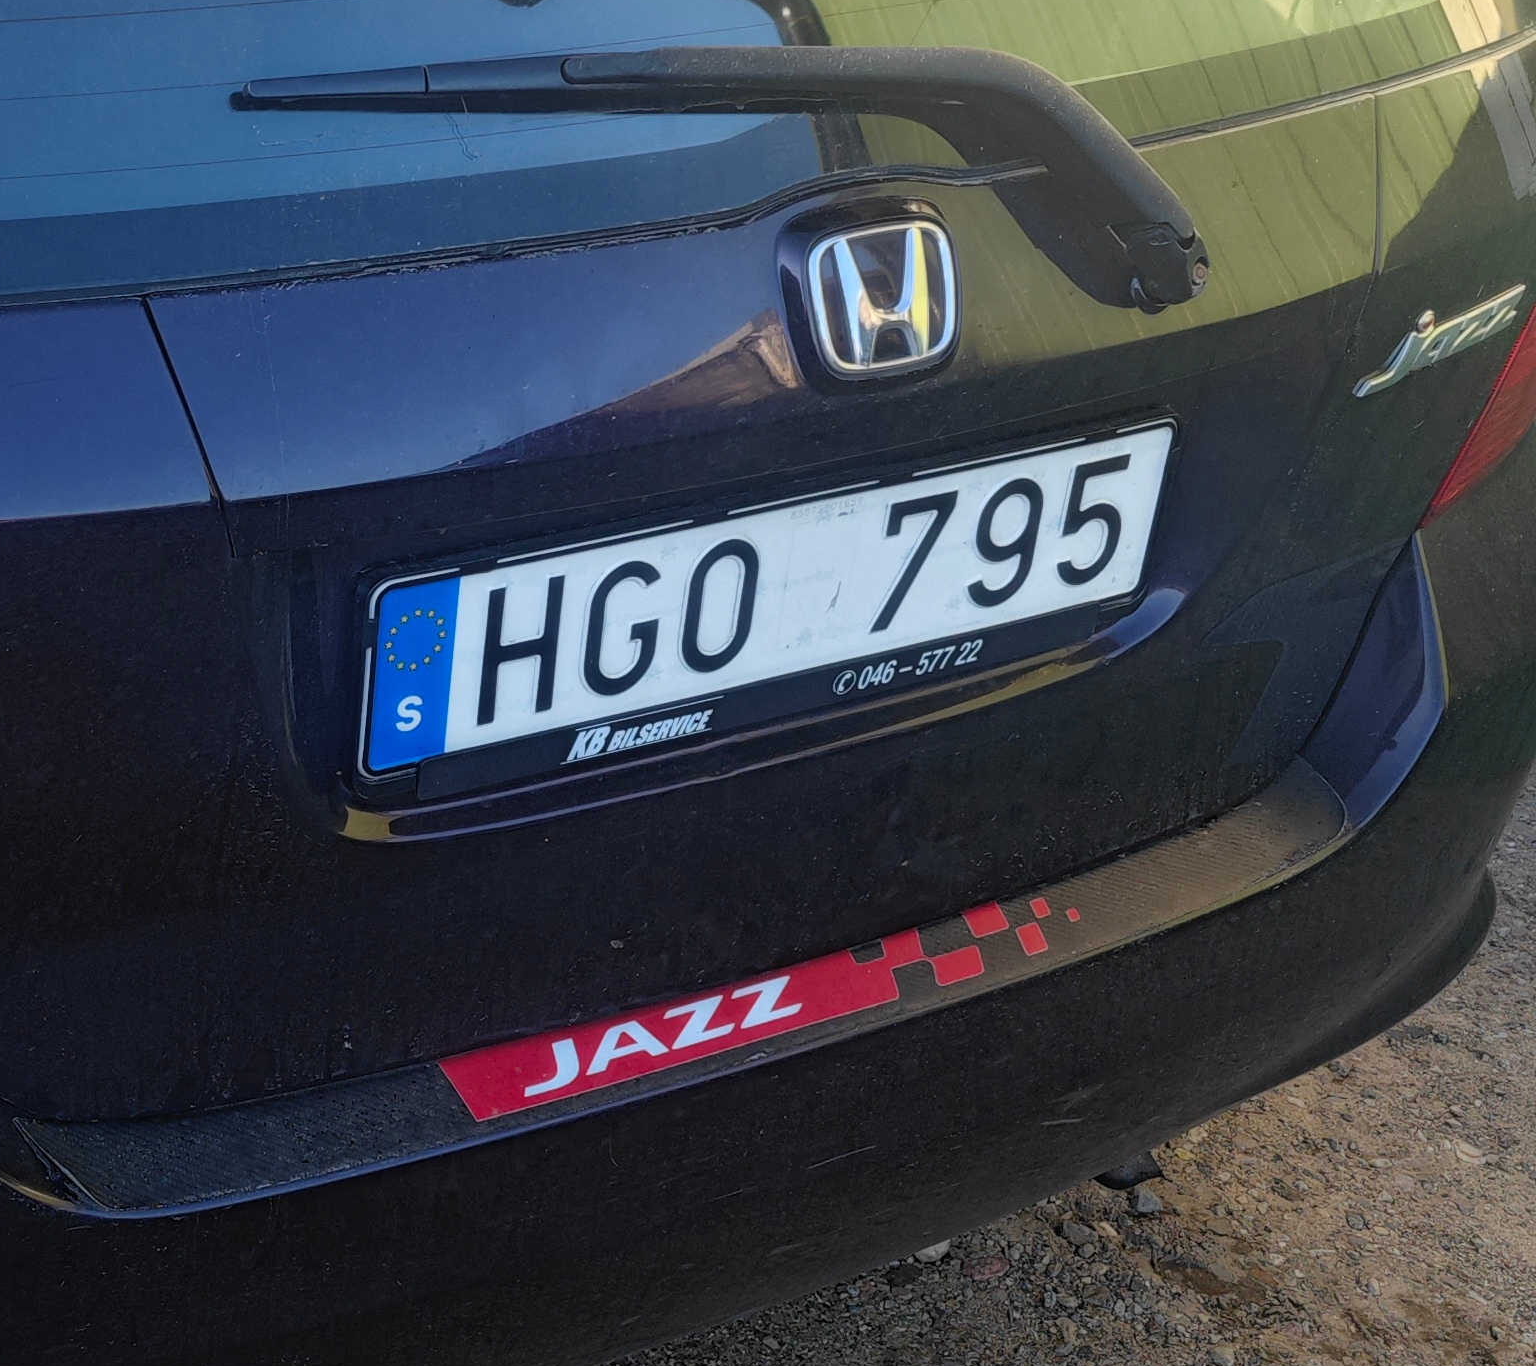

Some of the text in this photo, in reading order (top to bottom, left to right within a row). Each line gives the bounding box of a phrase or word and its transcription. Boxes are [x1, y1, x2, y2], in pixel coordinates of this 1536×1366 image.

[476, 454, 1132, 727] HGO 795
[395, 695, 424, 733] S
[606, 708, 714, 752] BILSERVICE
[523, 975, 802, 1097] JAZZ
